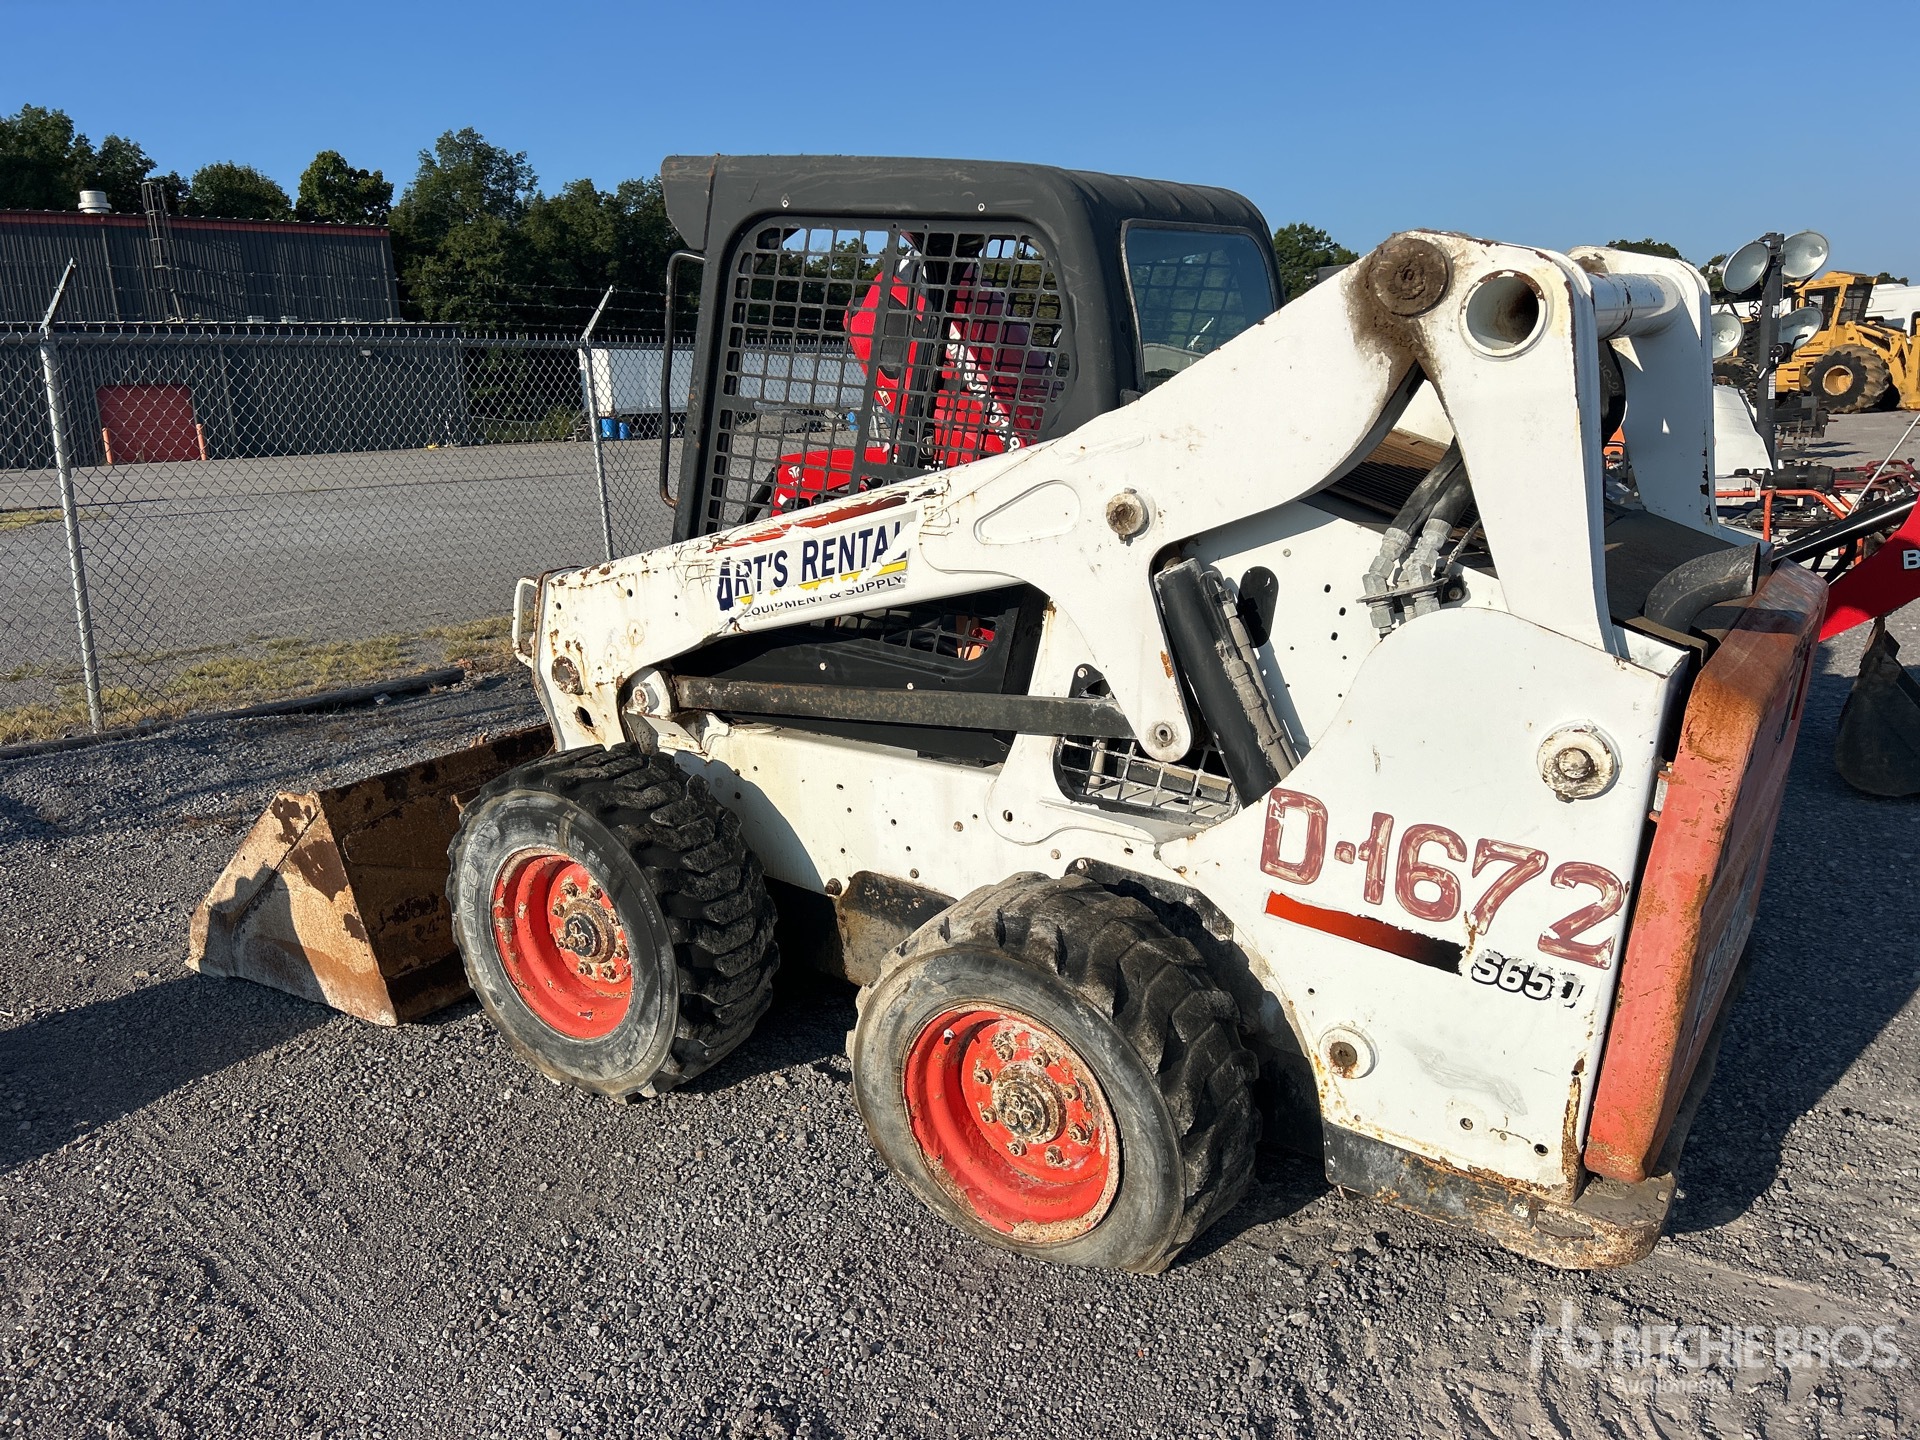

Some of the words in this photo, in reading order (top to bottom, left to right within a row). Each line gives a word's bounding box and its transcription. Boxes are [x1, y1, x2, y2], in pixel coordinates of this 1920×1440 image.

[717, 550, 788, 611] ART'S
[845, 576, 902, 596] SUPPLY
[1471, 948, 1586, 1009] S650
